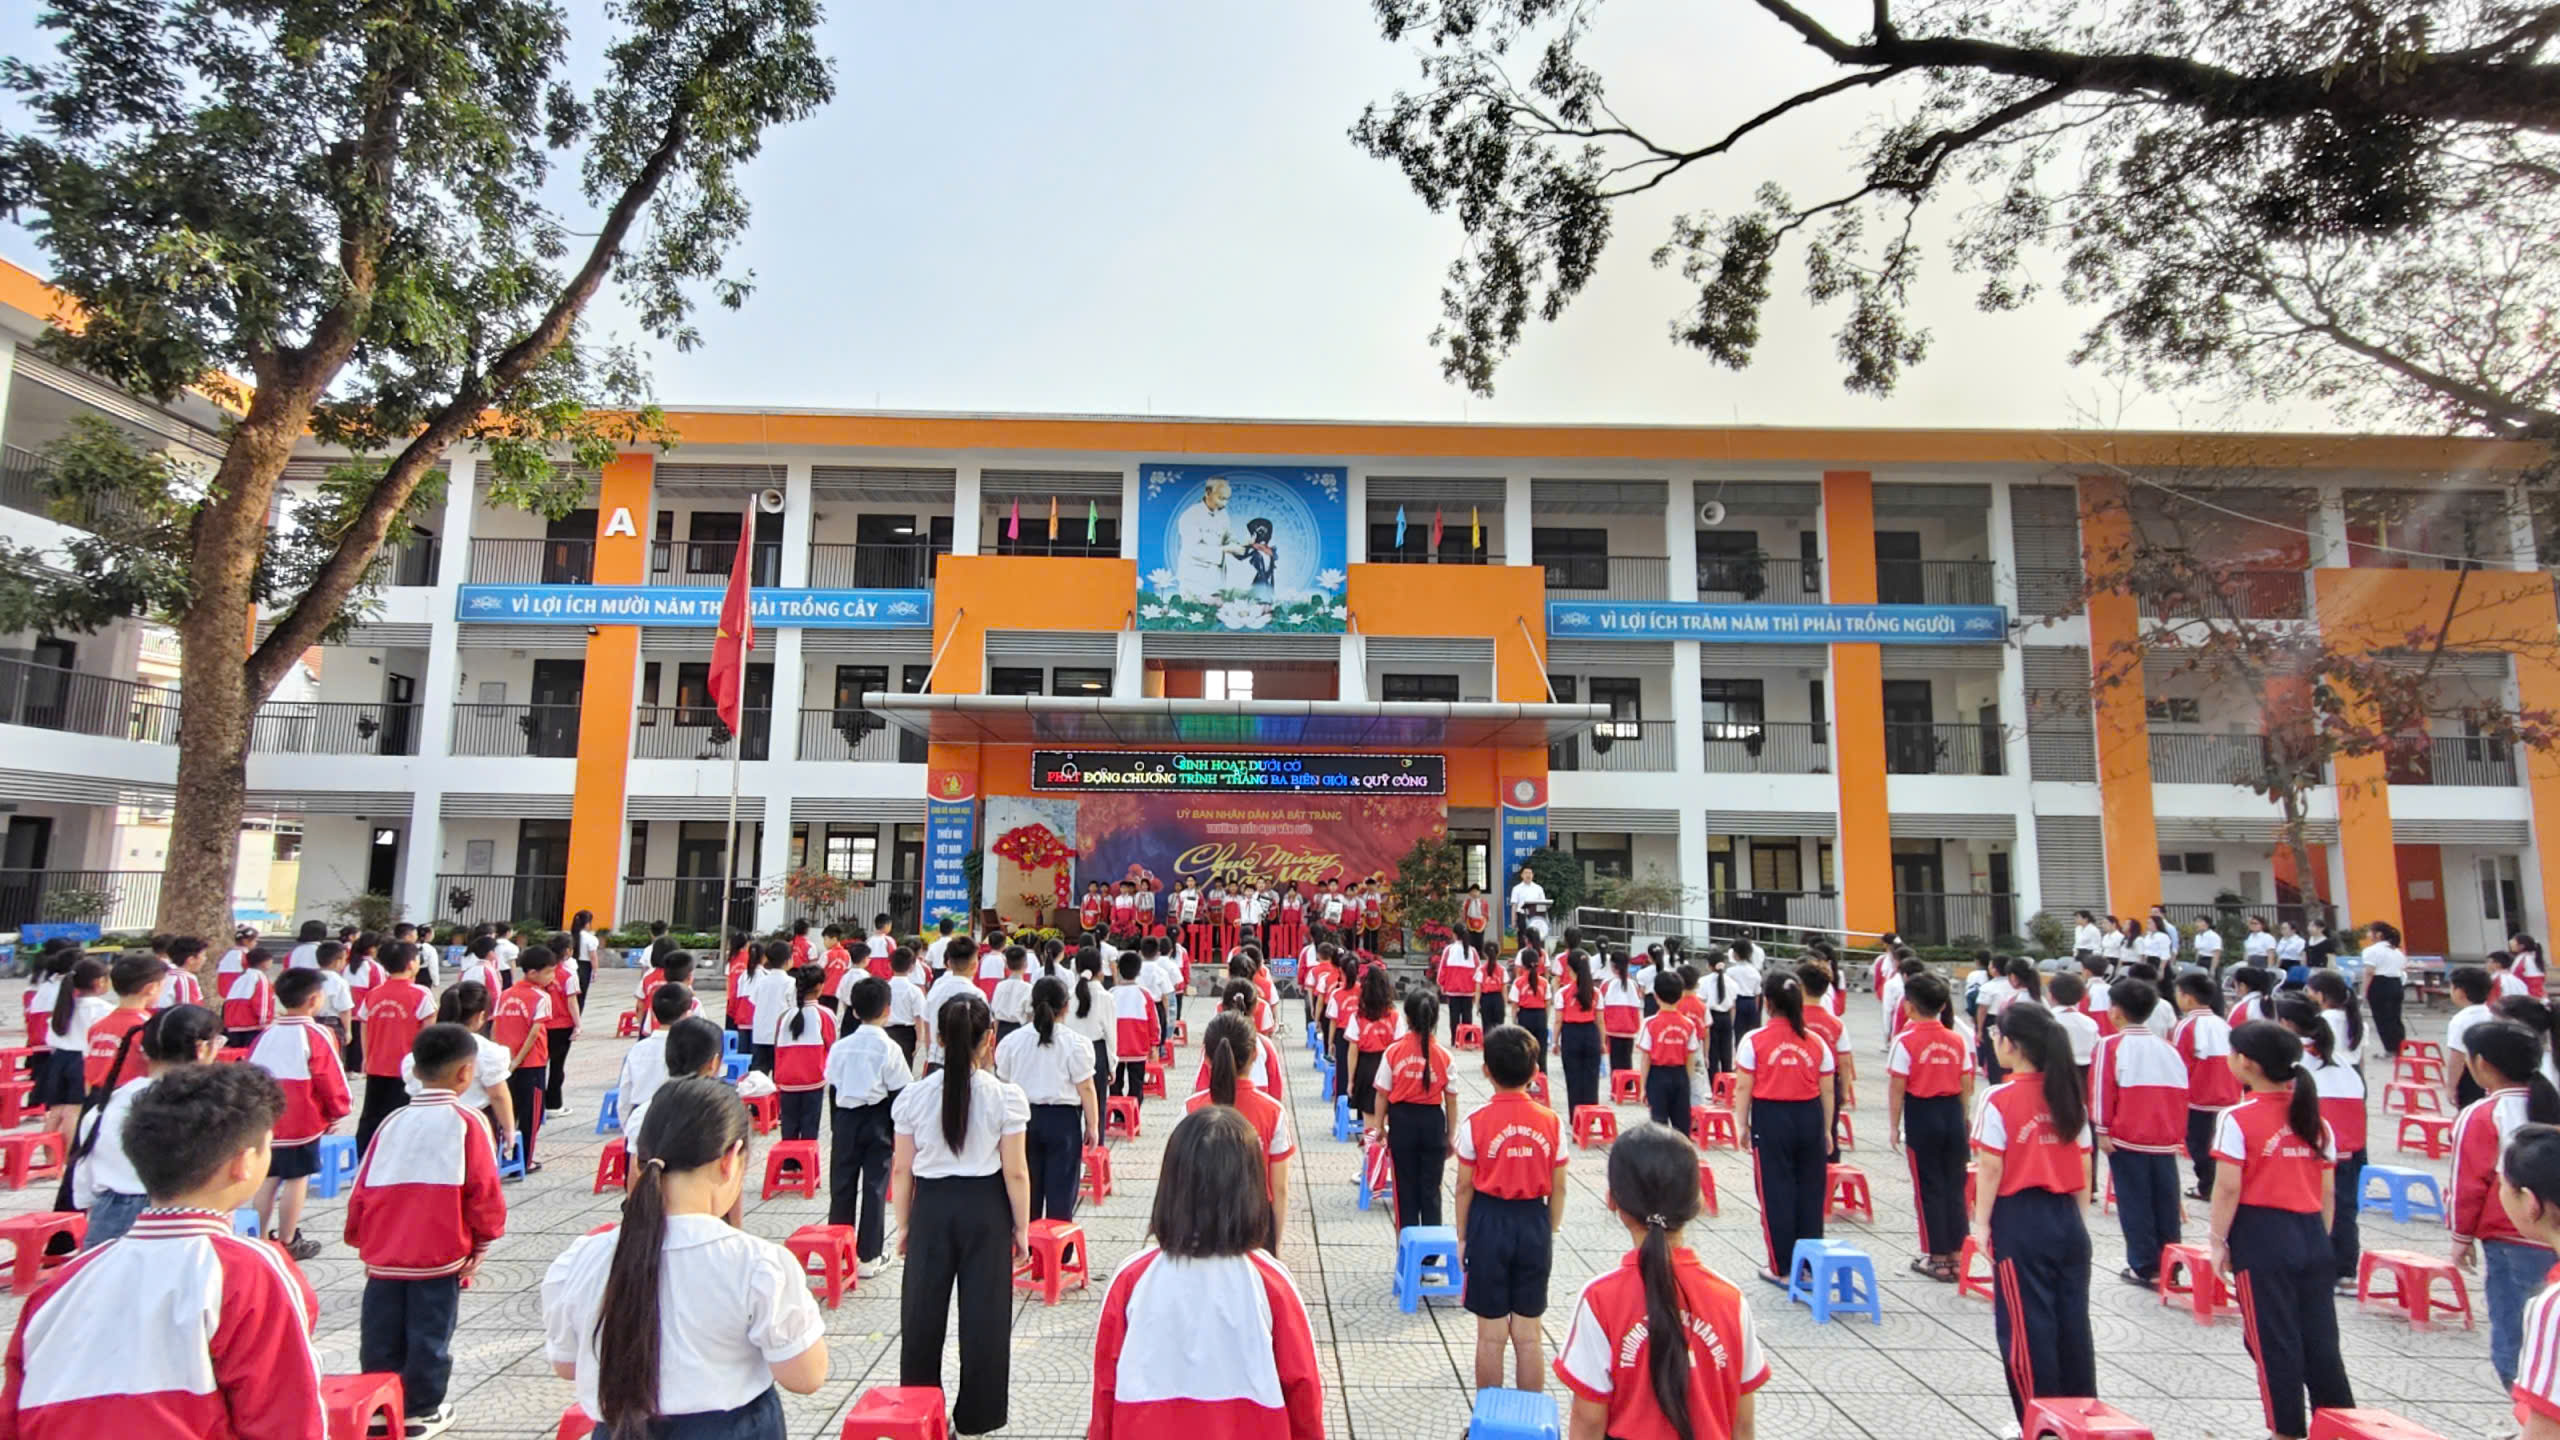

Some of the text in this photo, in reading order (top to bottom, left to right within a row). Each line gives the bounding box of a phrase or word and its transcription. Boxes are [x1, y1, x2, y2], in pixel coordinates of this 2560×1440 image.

[604, 507, 638, 537] A
[512, 594, 529, 613] VÌ
[533, 597, 561, 617] LỢI
[566, 594, 597, 614] ÍCH
[602, 596, 649, 615] MƯỜI
[654, 595, 695, 615] NĂM
[700, 600, 722, 616] TH
[780, 595, 840, 617] TRỒNG
[843, 598, 879, 617] CÂY
[1600, 610, 1956, 633] VÌ LỢI ÍCH TRĂM NĂM THÌ PHẢI TRỒNG NGƯỜI
[1179, 760, 1208, 770] SINH
[1249, 759, 1281, 771] DƯỚI
[1047, 767, 1081, 783] PHÁT
[1122, 772, 1177, 784] CHƯƠNG
[1178, 771, 1218, 784] TRÌNH
[1271, 775, 1288, 785] BA
[1291, 772, 1320, 786] BIÊN
[1322, 772, 1348, 787] GIỚI
[1350, 777, 1360, 786] &
[1362, 774, 1389, 788] QUỸ
[1392, 773, 1428, 787] CÔNG
[1192, 811, 1212, 819] BAN
[1215, 809, 1245, 820] NHÂN
[1247, 809, 1269, 820] DÂN
[1309, 810, 1343, 821] TRÀNG
[1174, 841, 1344, 875] Chúc Mừng
[1187, 923, 1213, 964] TH
[1692, 1318, 1719, 1347] VĂN
